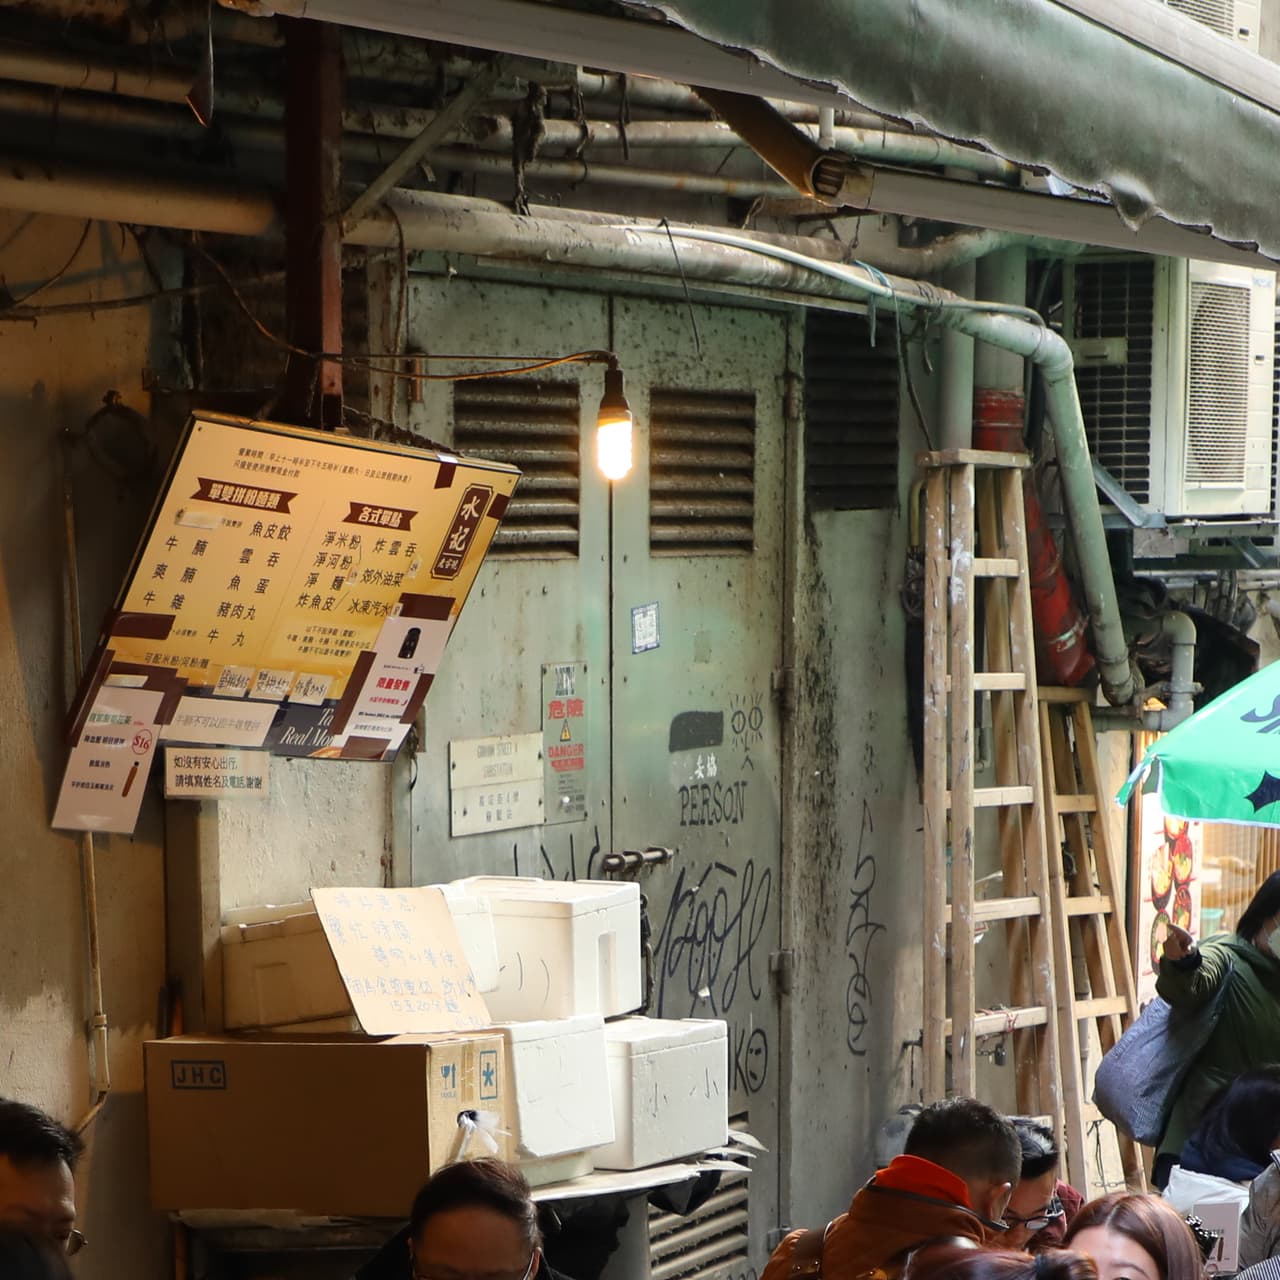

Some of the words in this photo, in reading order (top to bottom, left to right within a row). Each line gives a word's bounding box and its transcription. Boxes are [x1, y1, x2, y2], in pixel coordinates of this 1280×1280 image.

[358, 506, 402, 528] 各式單點
[449, 495, 481, 552] 水記
[249, 520, 292, 542] 魚皮餃
[240, 548, 280, 568] 雲吞
[372, 538, 418, 558] 炸雲吞
[227, 575, 270, 595] 魚蛋
[360, 568, 404, 588] 郊外油菜
[217, 601, 256, 621] 豬肉丸
[296, 592, 336, 612] 炸魚皮
[207, 628, 247, 647] 牛丸
[548, 698, 584, 720] 危險
[279, 726, 311, 746] Real
[548, 744, 584, 758] DANGER
[678, 780, 748, 826] PERSON
[177, 1062, 222, 1084] JHC
